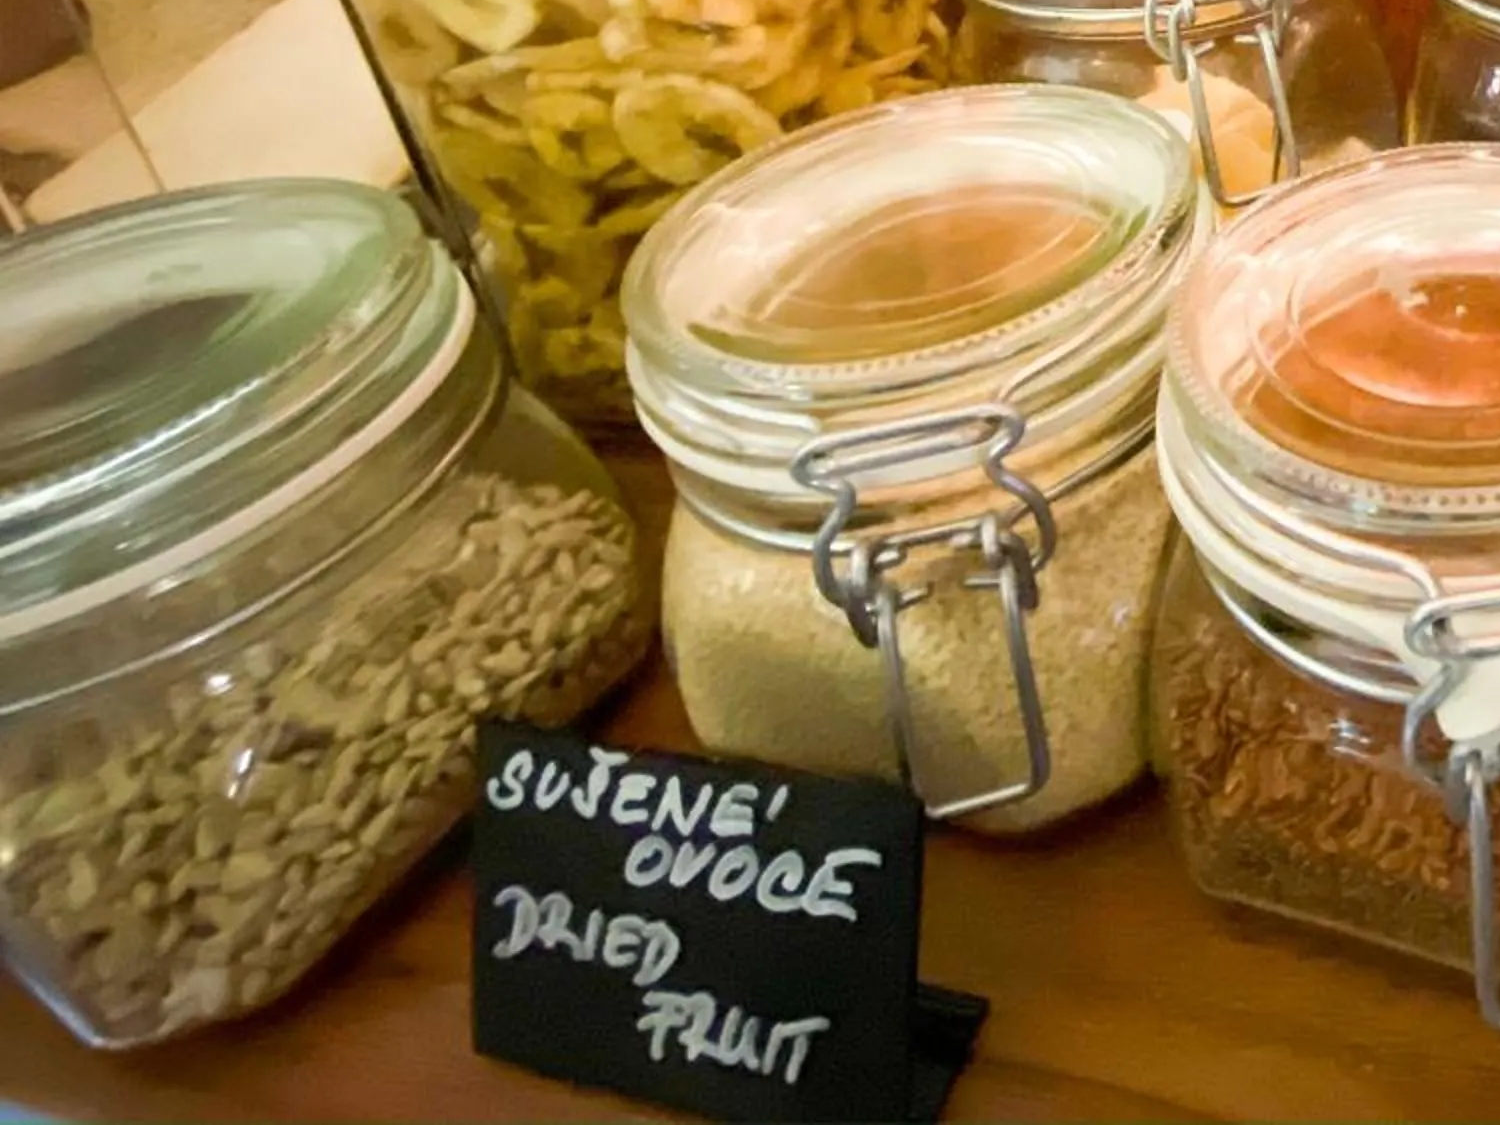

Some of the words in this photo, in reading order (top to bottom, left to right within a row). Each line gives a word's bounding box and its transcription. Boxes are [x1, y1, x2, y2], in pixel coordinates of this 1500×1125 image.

[625, 835, 882, 920] OVOCE
[493, 885, 681, 986] DRIED
[637, 991, 830, 1084] FRUIT
